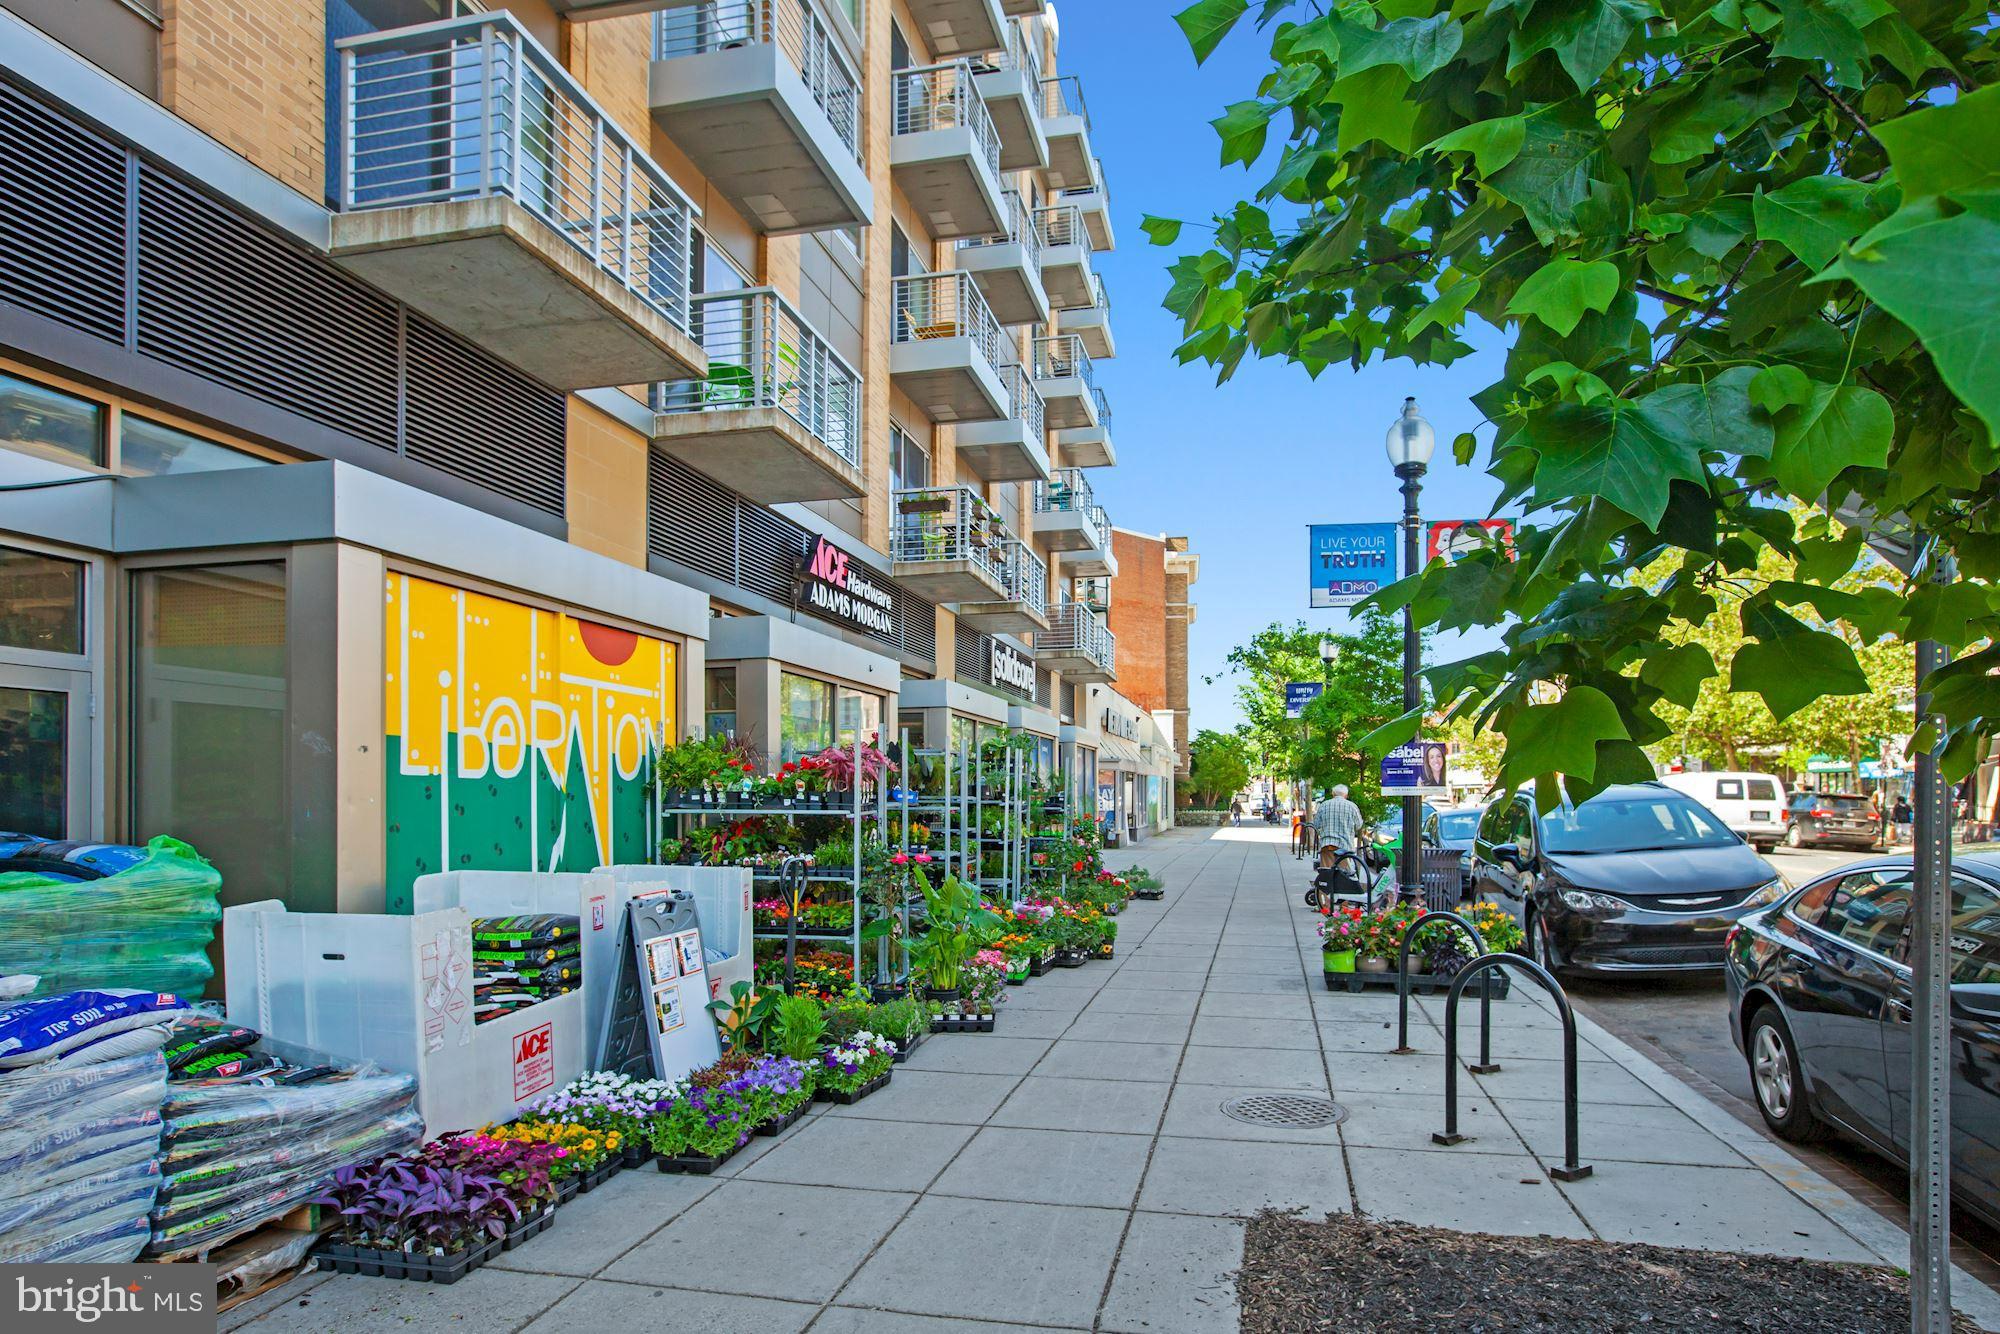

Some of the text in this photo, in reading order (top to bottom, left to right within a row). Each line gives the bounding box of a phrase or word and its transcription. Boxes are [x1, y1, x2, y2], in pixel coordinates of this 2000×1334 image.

[1321, 536, 1385, 548] LIVE YOUR
[810, 536, 849, 588] ACE
[1321, 550, 1386, 568] TRUTH
[847, 571, 892, 610] Hardware
[1330, 581, 1378, 594] ADMO
[810, 582, 892, 635] ADAMS MORGAN
[1388, 746, 1424, 759] sabel
[41, 1020, 70, 1037] TOP
[71, 1008, 105, 1026] SOIL
[516, 1030, 550, 1064] ACE
